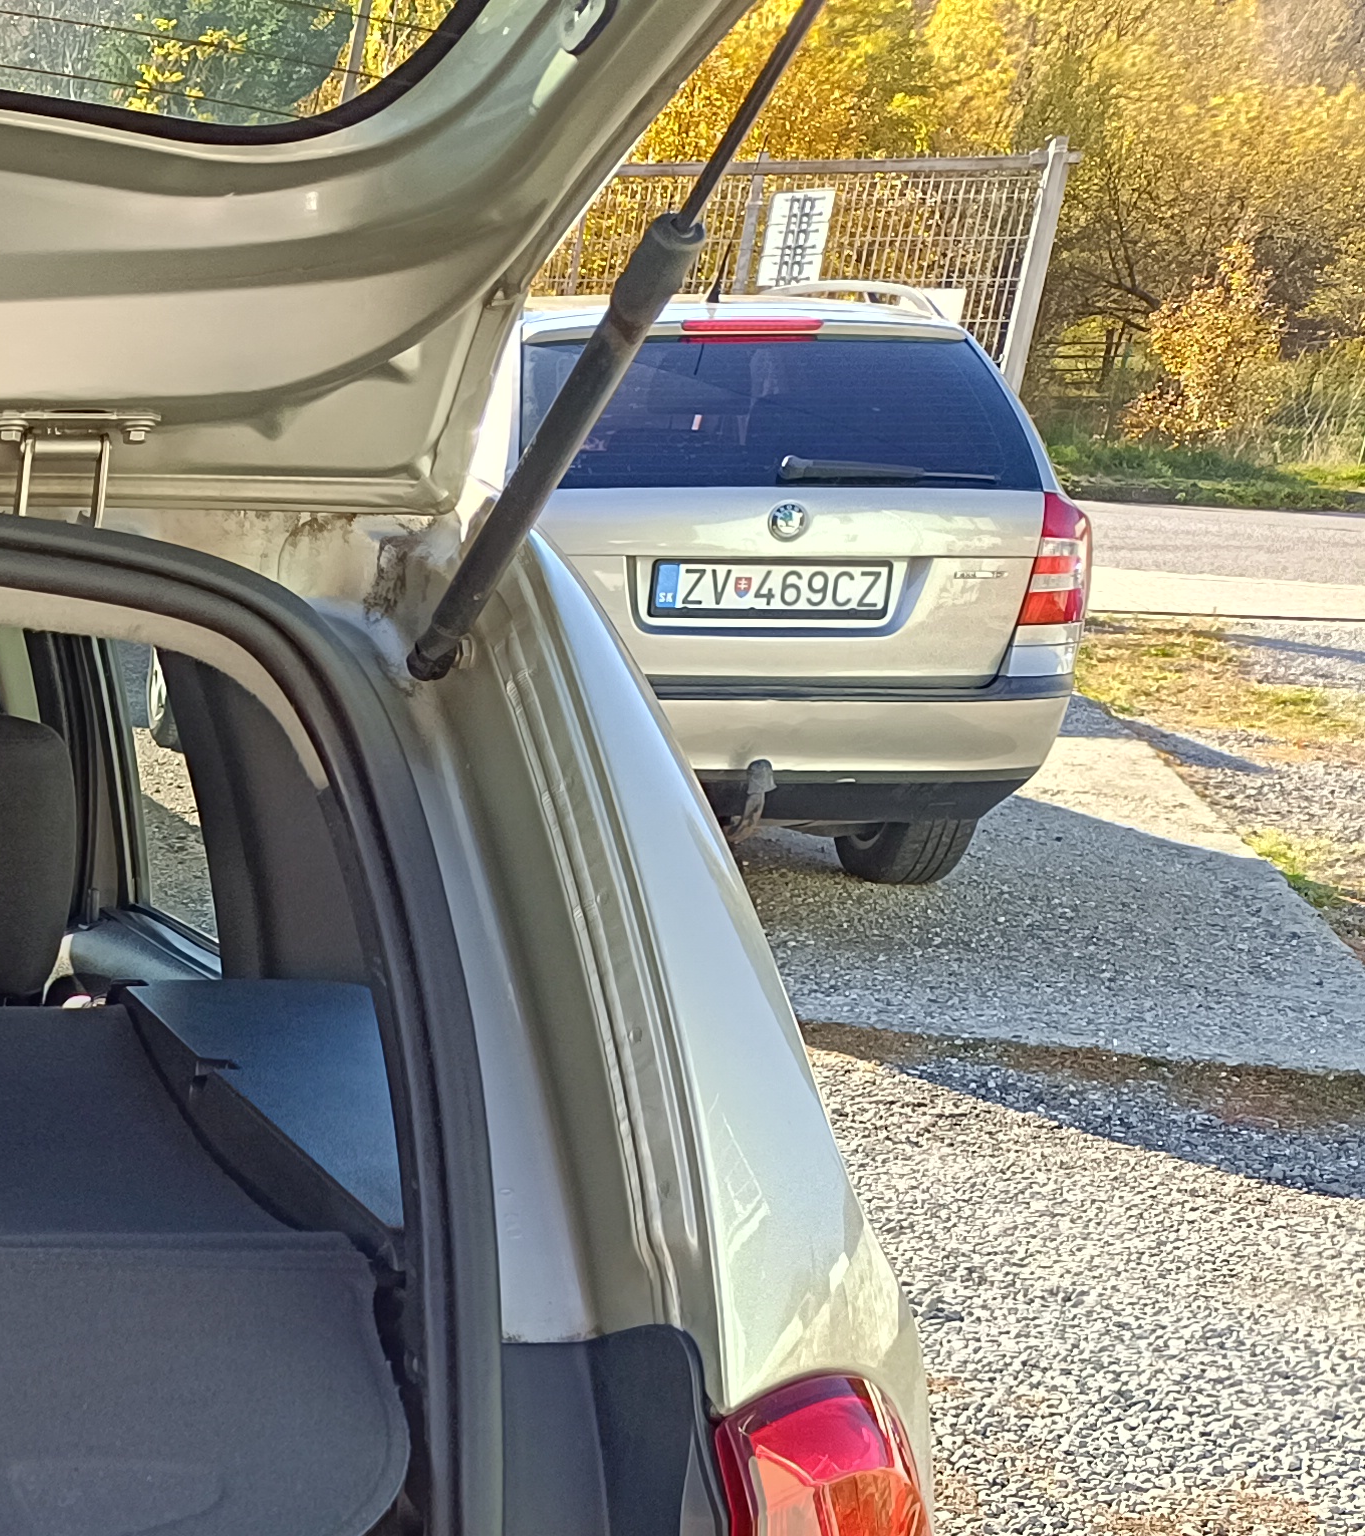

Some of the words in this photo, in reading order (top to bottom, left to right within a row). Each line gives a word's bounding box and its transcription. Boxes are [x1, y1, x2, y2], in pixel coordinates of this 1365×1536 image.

[658, 592, 674, 603] SK
[681, 568, 733, 605] ZV
[753, 569, 882, 608] 469CZ
